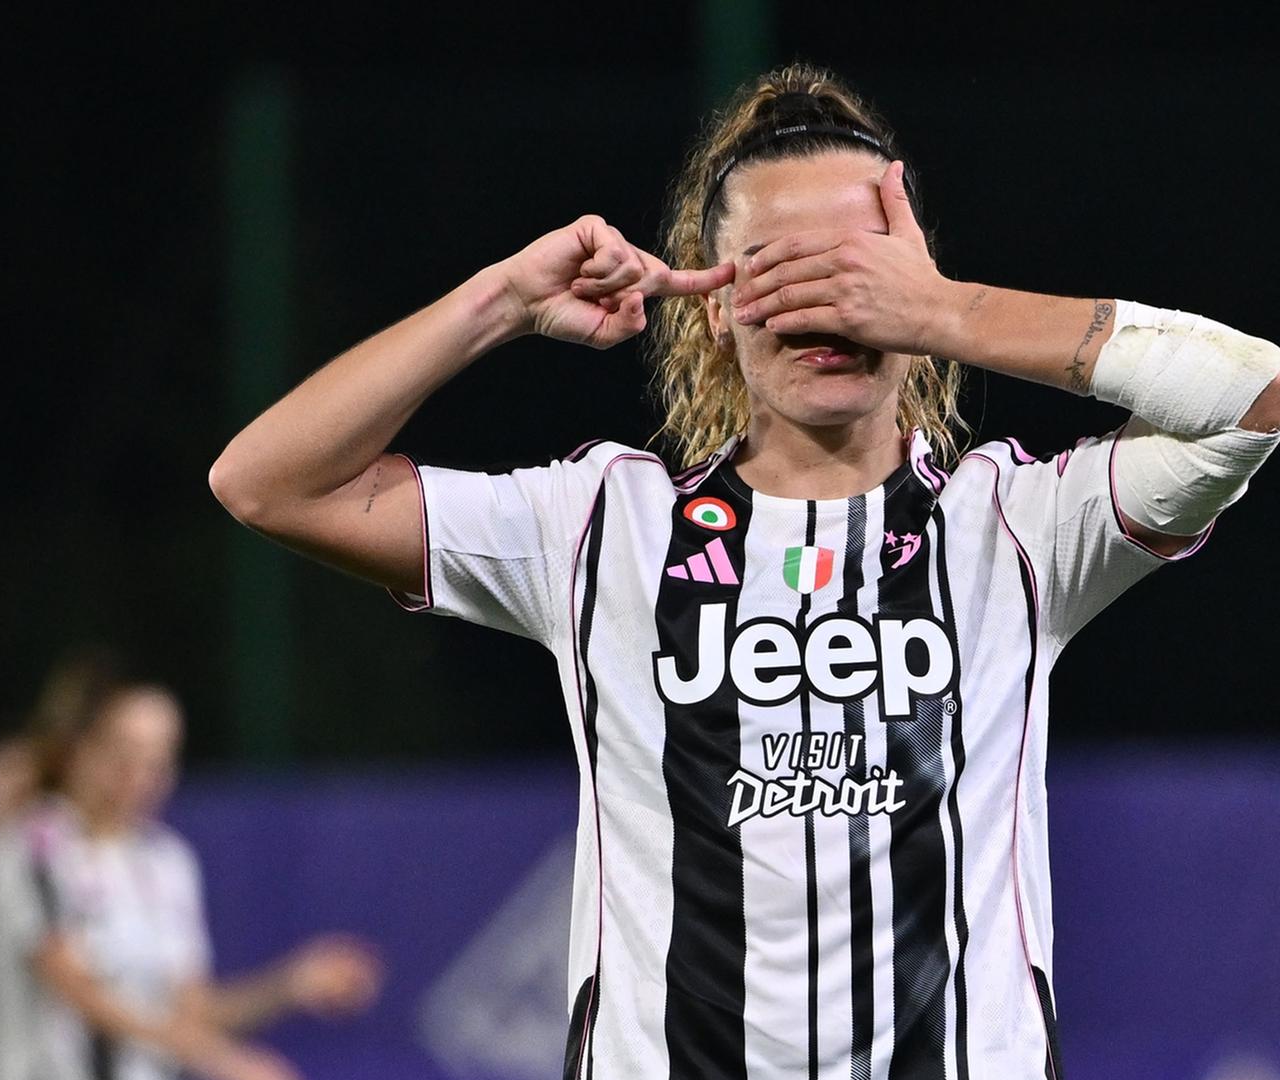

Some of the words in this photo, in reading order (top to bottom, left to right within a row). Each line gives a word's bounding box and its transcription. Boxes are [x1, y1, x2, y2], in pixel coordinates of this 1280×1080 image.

[655, 602, 954, 716] Jeep
[762, 732, 864, 770] VISIT
[726, 768, 907, 828] Detroit
